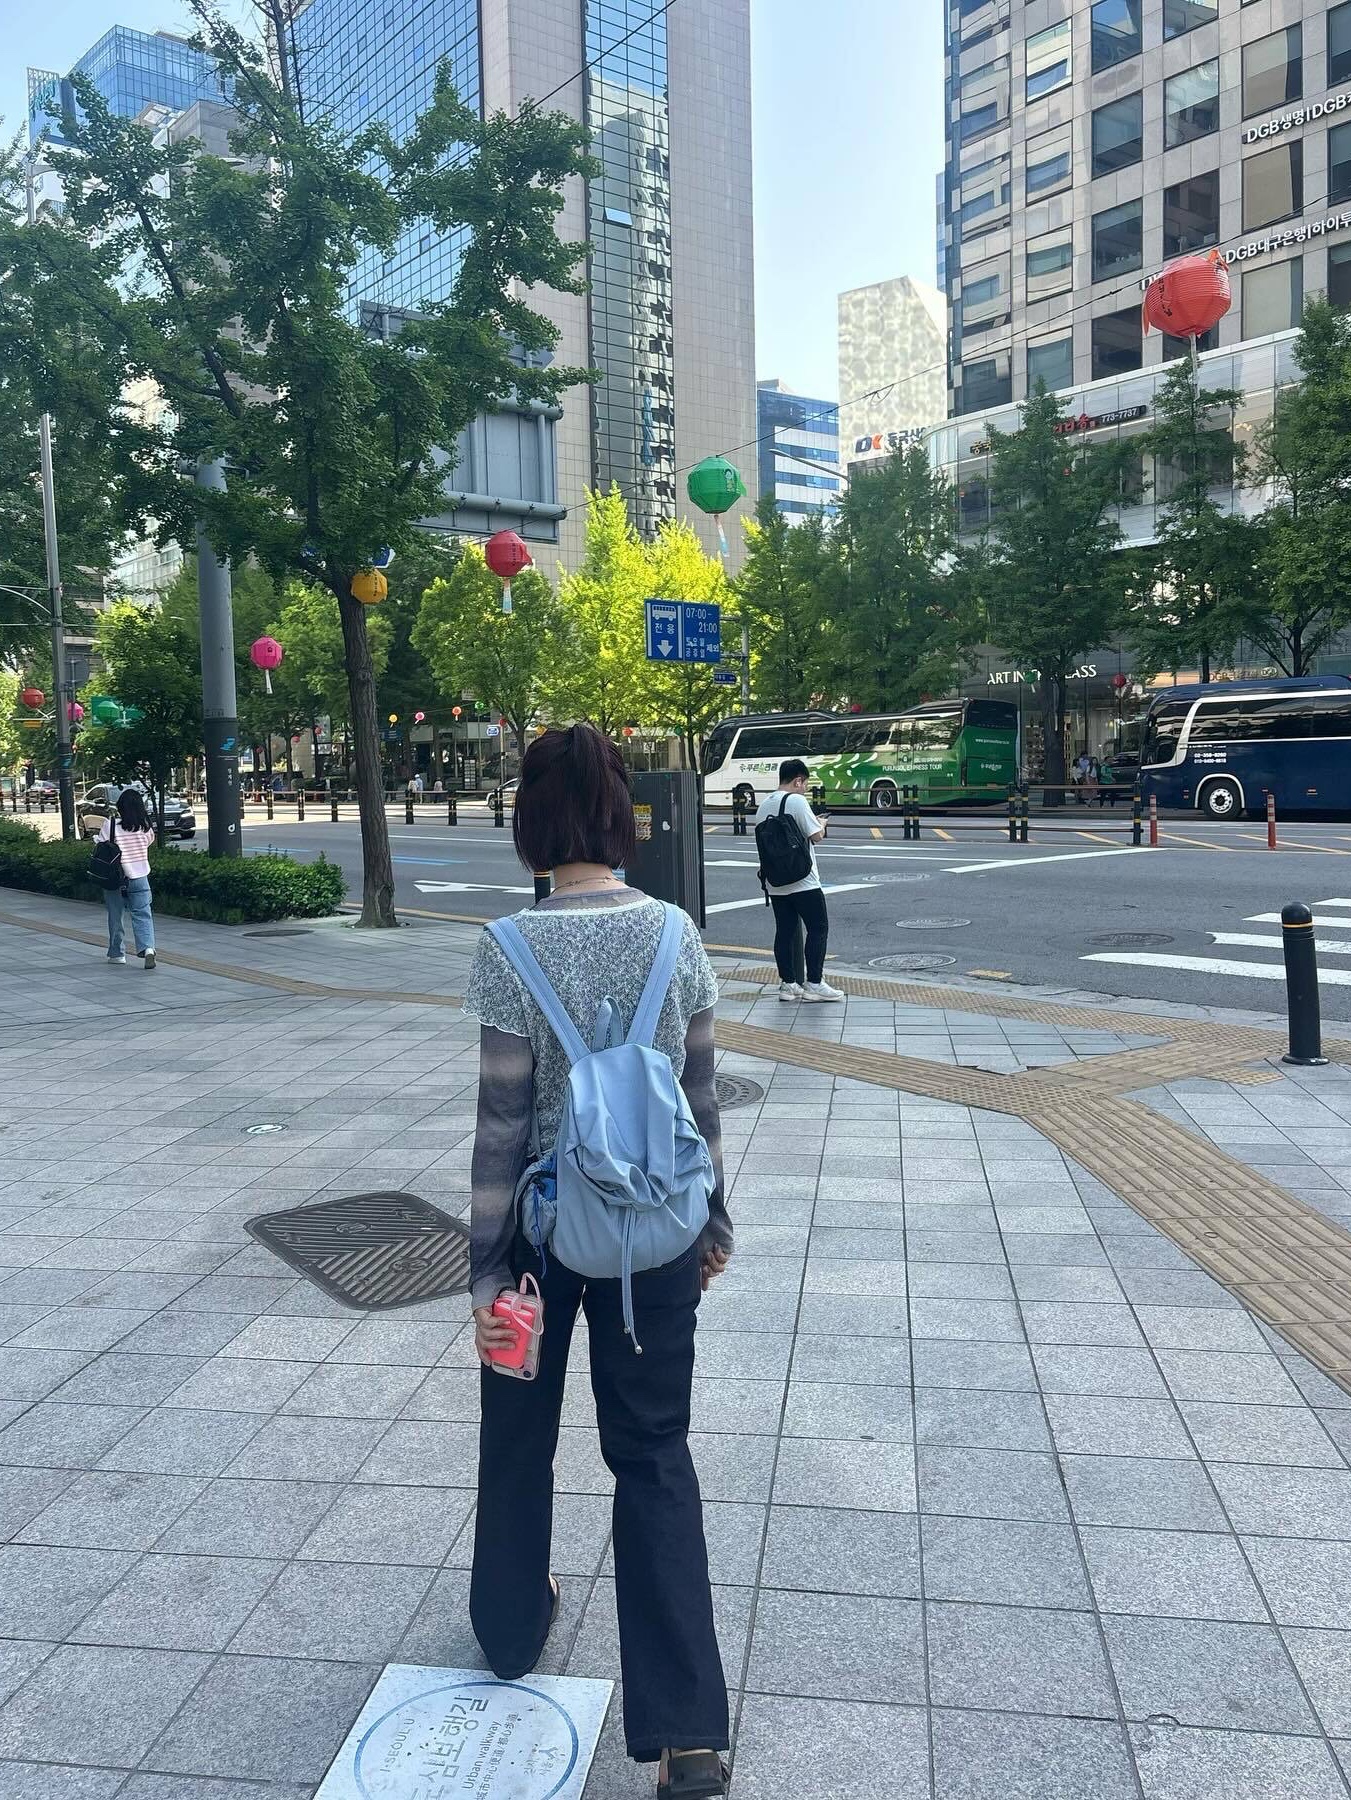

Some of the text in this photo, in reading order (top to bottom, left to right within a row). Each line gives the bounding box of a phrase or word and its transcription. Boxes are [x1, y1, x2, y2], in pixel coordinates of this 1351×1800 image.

[1102, 407, 1137, 423] 773-7737
[698, 622, 718, 633] 21:00
[987, 671, 1011, 685] ART
[461, 1720, 503, 1790] Urban walkway
